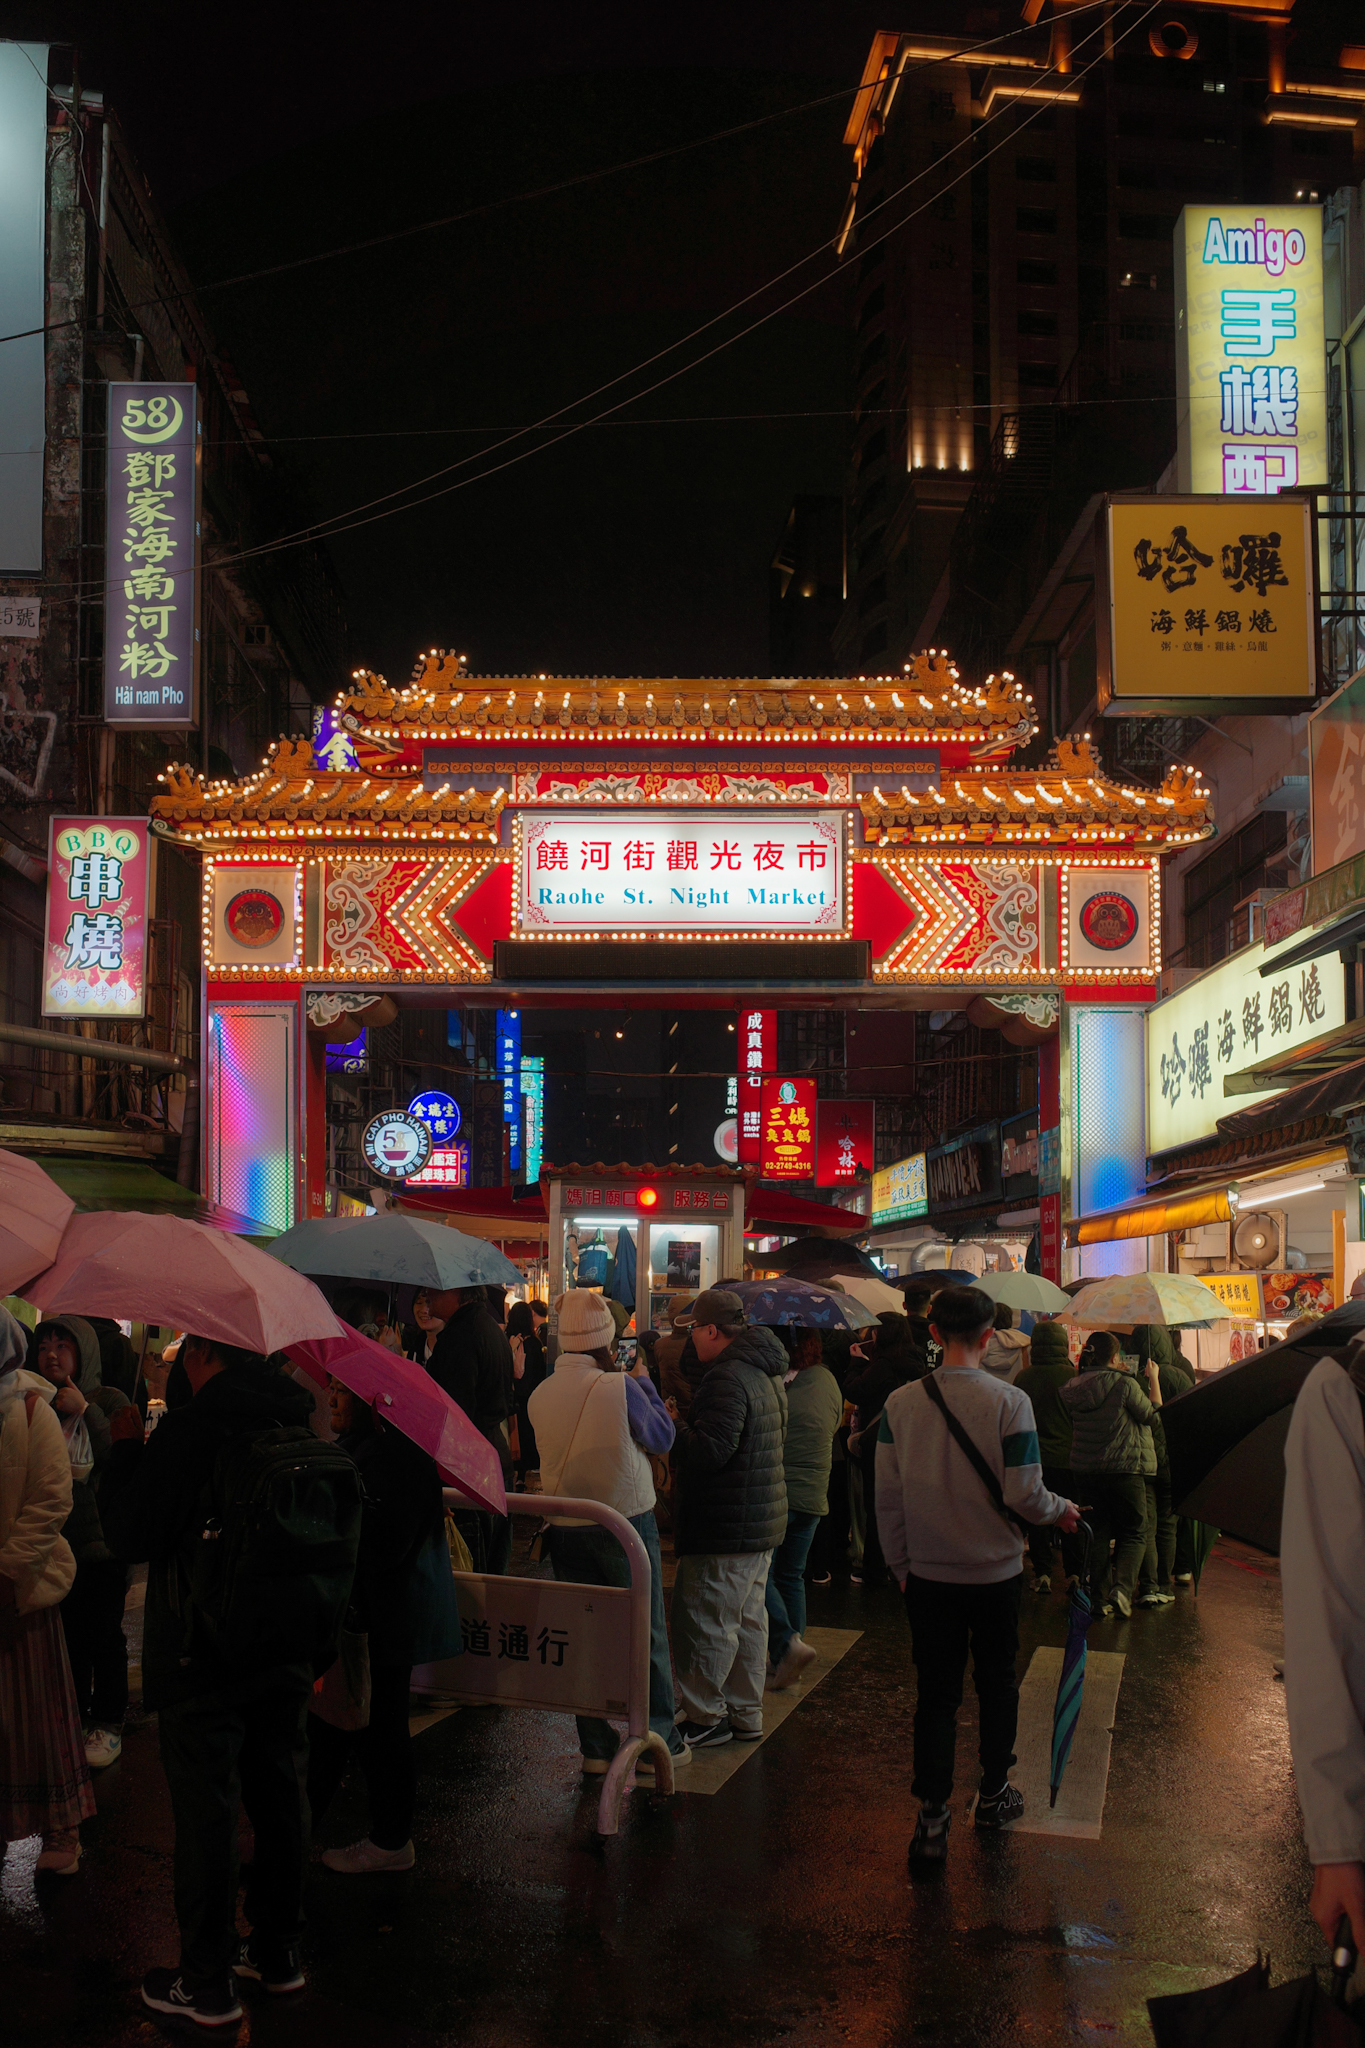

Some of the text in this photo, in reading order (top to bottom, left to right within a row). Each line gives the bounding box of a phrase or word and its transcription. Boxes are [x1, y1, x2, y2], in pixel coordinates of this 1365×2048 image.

[1203, 217, 1305, 276] Amigo
[1220, 289, 1299, 494] 手機配
[121, 397, 170, 429] 58
[119, 451, 178, 680] 鄧家海南河粉
[1134, 525, 1289, 597] 哈囉
[0, 607, 35, 628] 5號
[1150, 608, 1278, 637] 海鮮鍋燒
[115, 686, 184, 705] Hải nam Pho
[65, 832, 132, 855] BBQ
[536, 839, 829, 872] 饒河街觀光夜市
[63, 852, 124, 970] 串燒
[538, 887, 827, 909] Raohe St. Night Market
[54, 985, 128, 1001] 尚好烤肉
[746, 1012, 763, 1088] 成真鑽石
[767, 1106, 810, 1128] 三媽
[364, 1112, 429, 1156] MI CAY PHO HAINAM
[766, 1128, 812, 1144] 臭臭鍋
[764, 1161, 812, 1170] 02-2749-4316
[837, 1134, 857, 1169] 哈林
[565, 1188, 730, 1210] 媽祖廟口 服務台
[461, 1617, 570, 1667] 道通行
